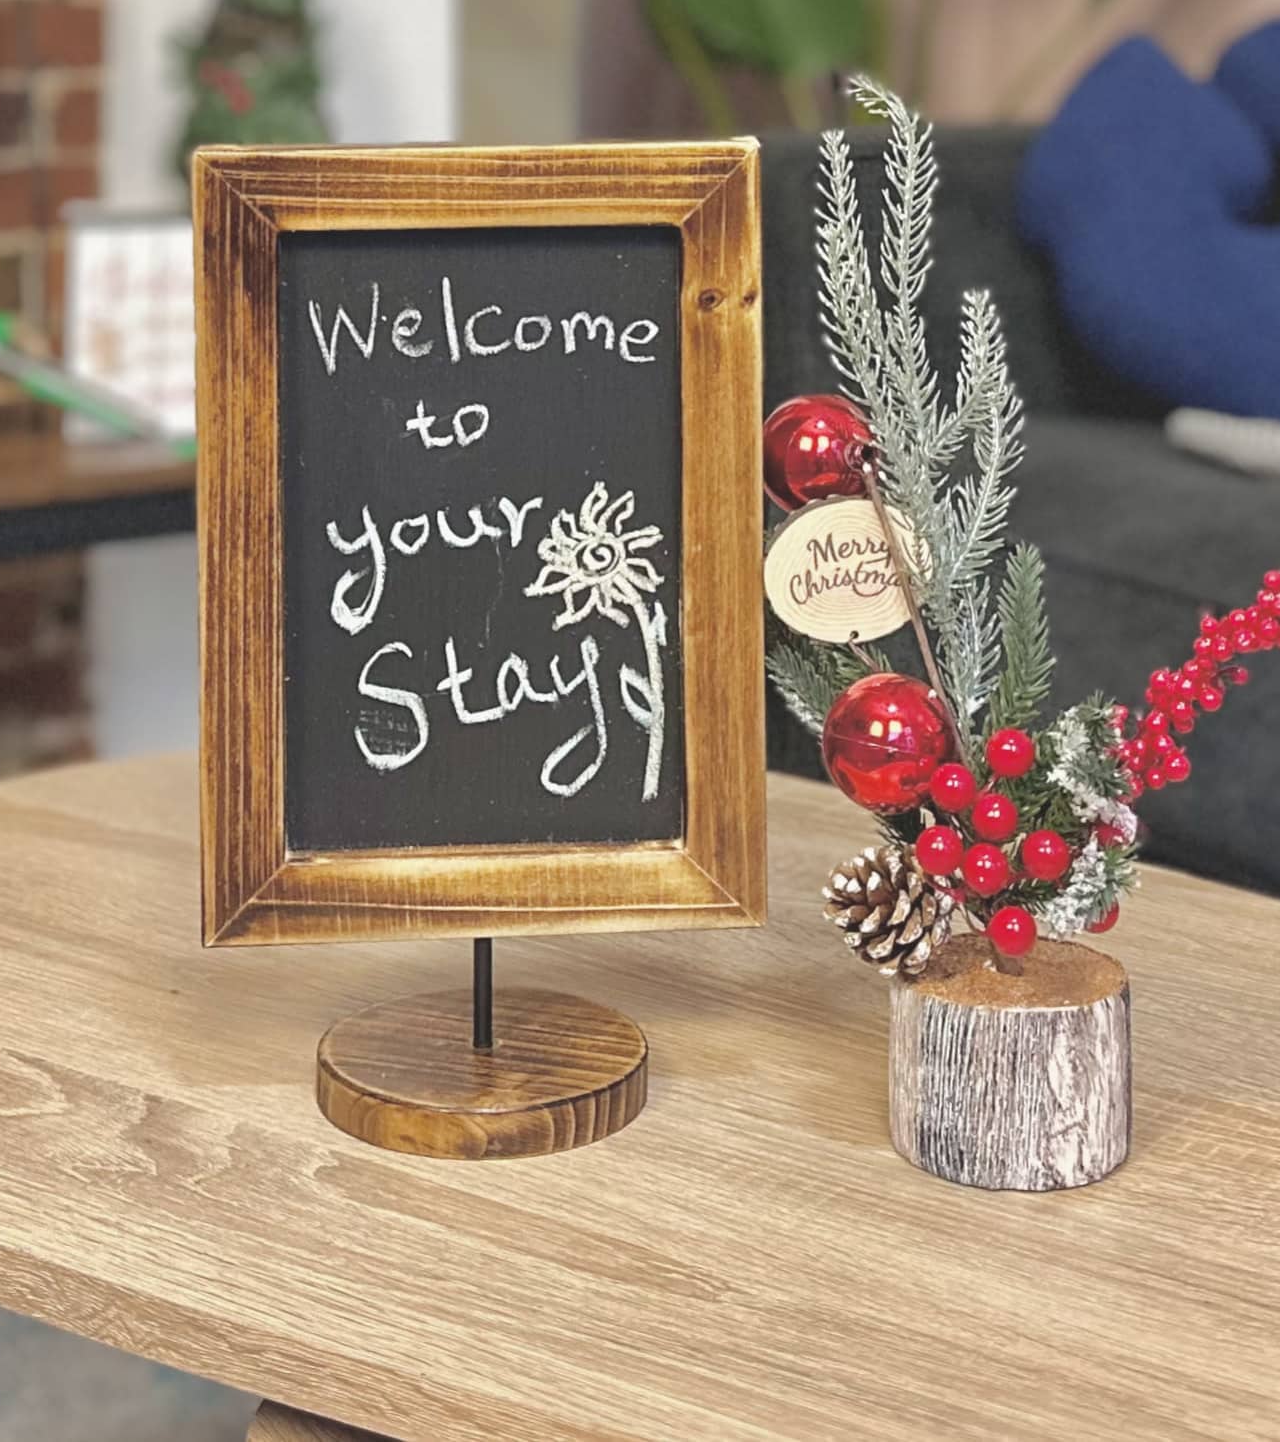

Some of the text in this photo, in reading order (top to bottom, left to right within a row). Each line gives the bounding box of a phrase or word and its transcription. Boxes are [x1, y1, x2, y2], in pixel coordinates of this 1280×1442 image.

[308, 277, 660, 376] Welcome
[405, 398, 490, 447] to
[326, 495, 543, 636] your
[806, 532, 892, 571] Merry
[354, 635, 609, 798] Stay
